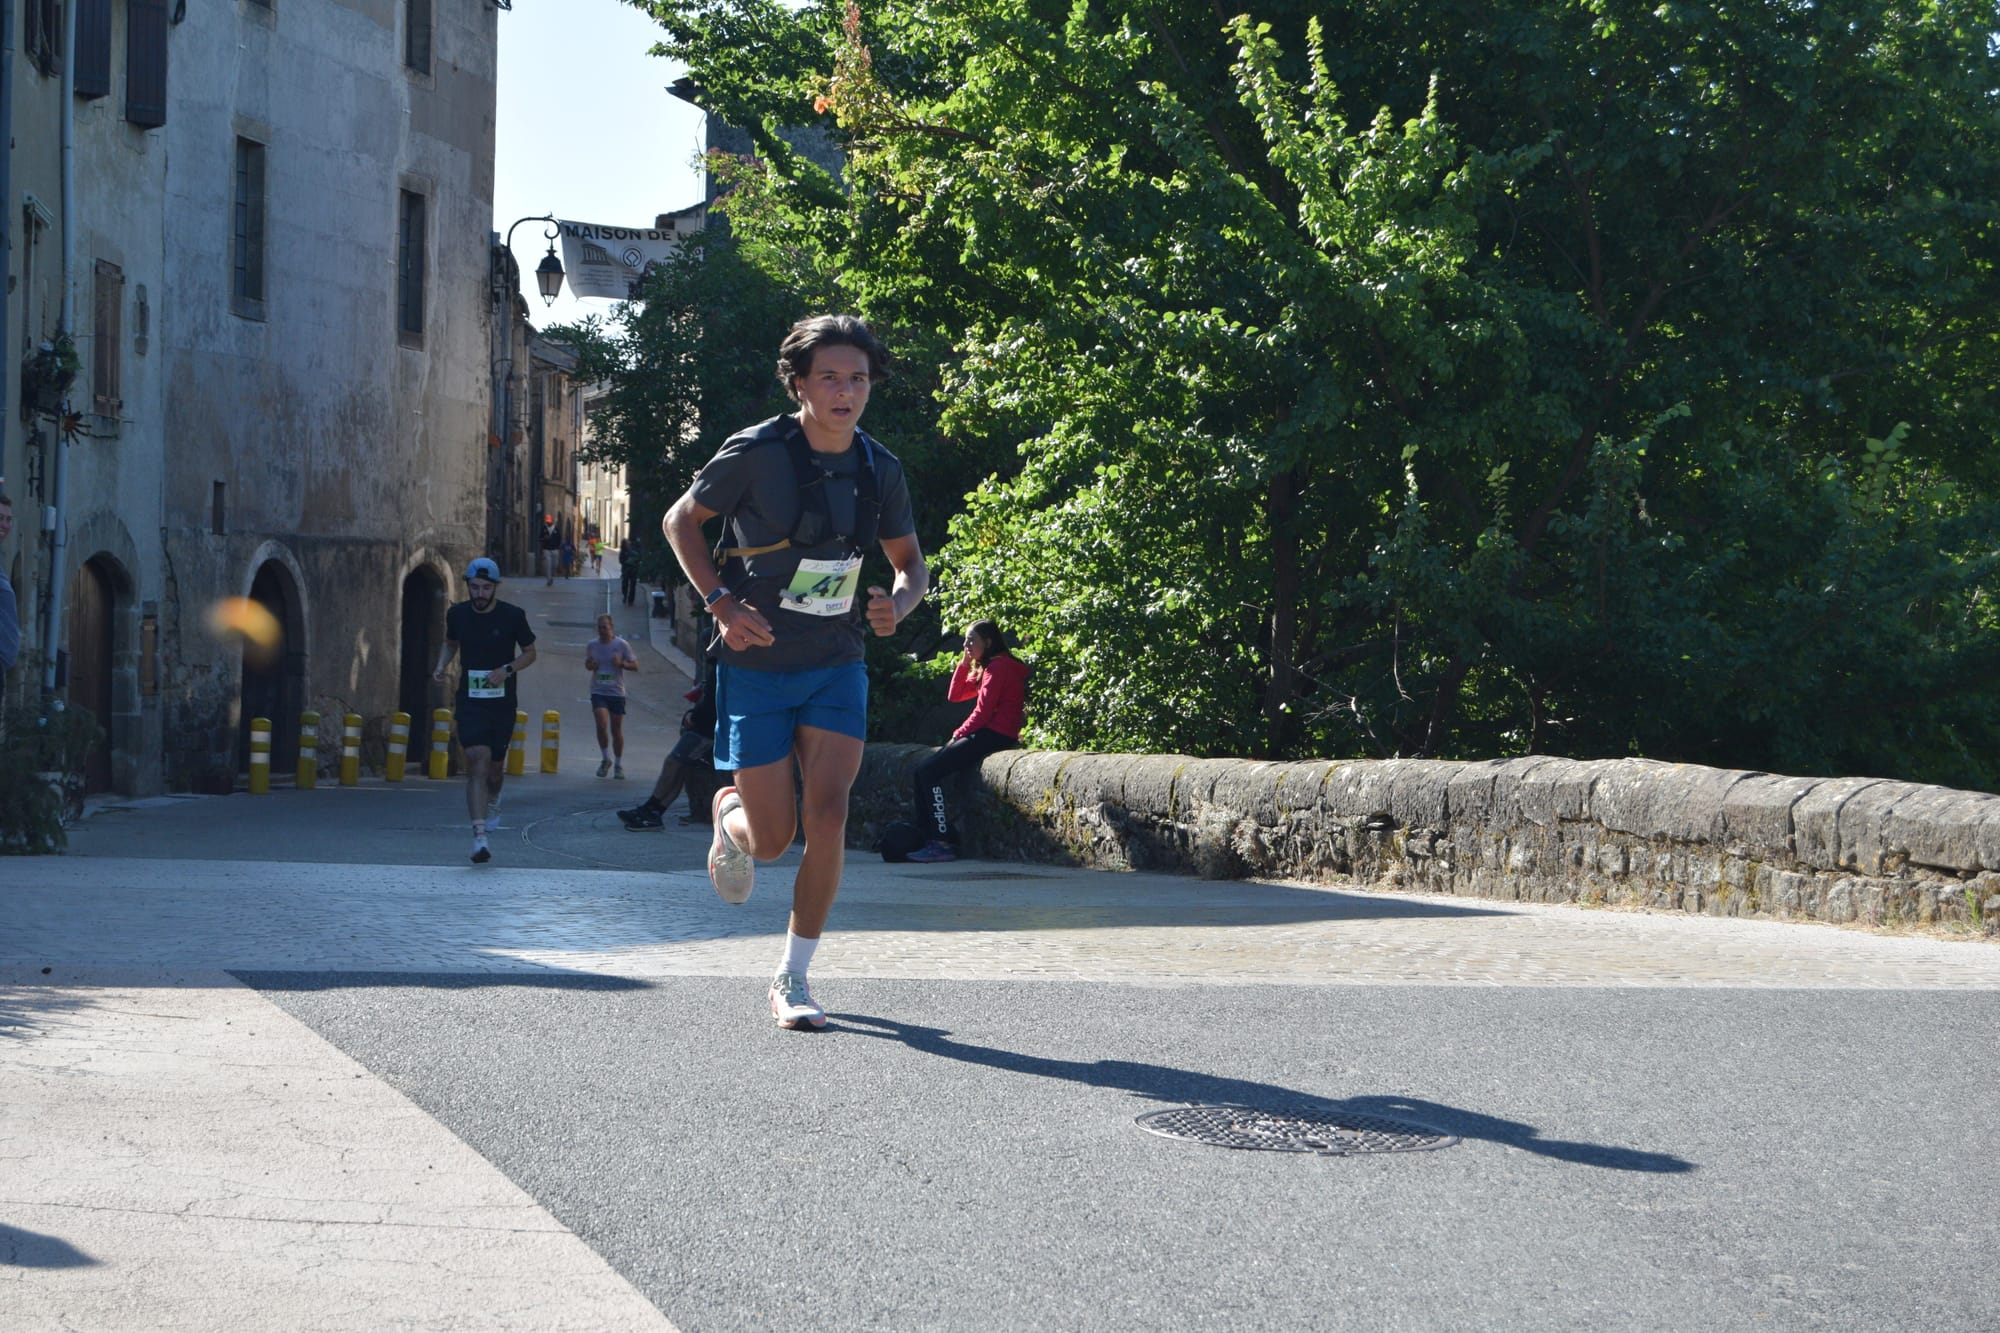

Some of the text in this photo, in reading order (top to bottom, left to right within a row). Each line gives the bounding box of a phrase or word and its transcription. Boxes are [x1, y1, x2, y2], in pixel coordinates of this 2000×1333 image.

[565, 225, 642, 241] MAISON
[648, 230, 671, 241] DE
[811, 575, 849, 598] 47
[473, 677, 498, 689] 12
[932, 786, 947, 833] adidas
